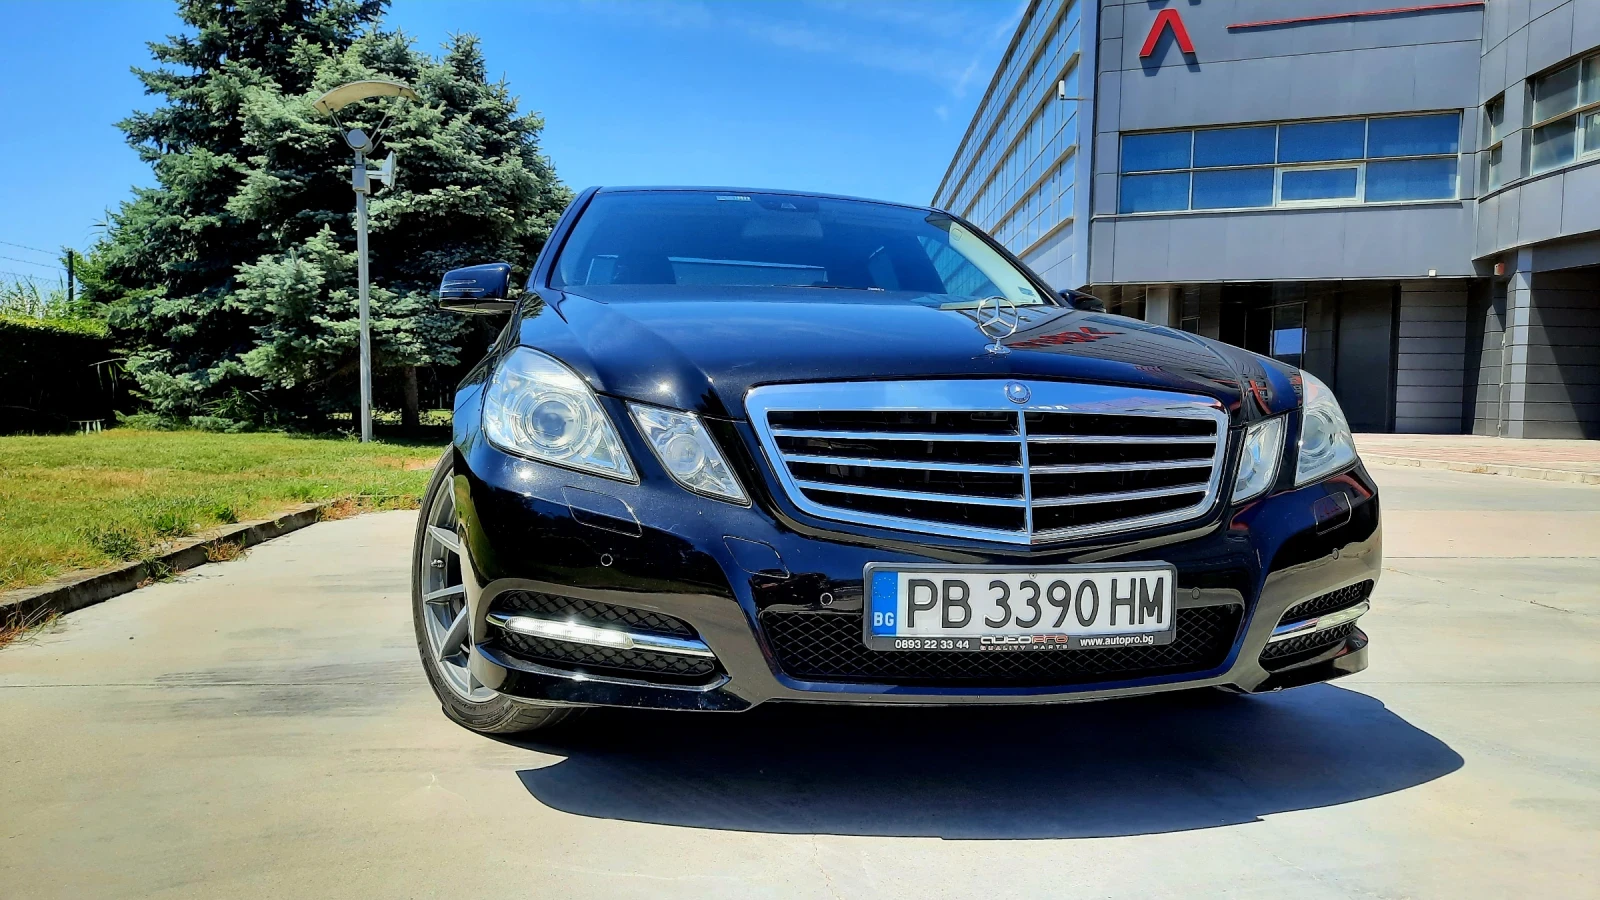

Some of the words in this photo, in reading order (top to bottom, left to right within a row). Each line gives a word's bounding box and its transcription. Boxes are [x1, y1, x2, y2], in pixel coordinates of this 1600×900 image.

[907, 578, 973, 629] PB
[984, 579, 1100, 629] 3390
[1109, 577, 1165, 626] HM
[873, 611, 895, 627] BG
[895, 639, 921, 649] 0893
[924, 639, 937, 649] 22
[940, 639, 953, 649] 33
[956, 639, 969, 649] 44
[1080, 634, 1154, 647] www.autopro.bg
